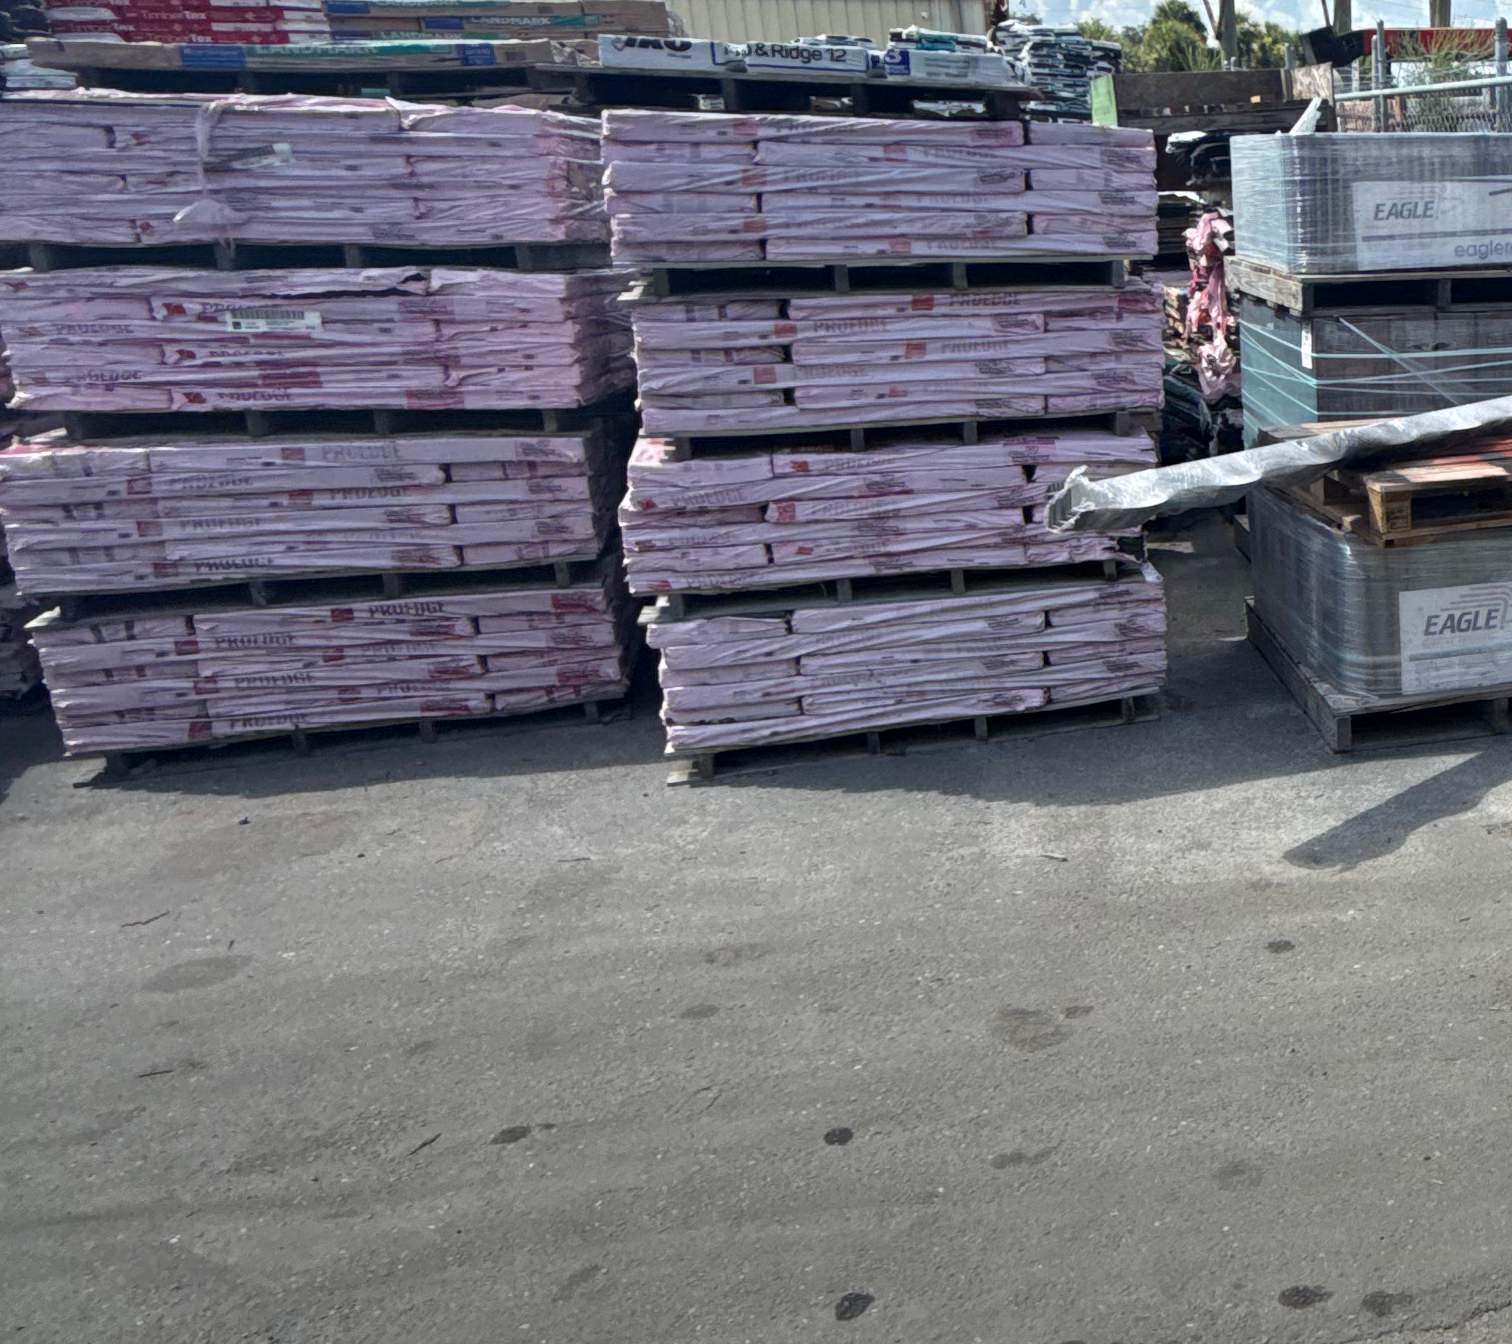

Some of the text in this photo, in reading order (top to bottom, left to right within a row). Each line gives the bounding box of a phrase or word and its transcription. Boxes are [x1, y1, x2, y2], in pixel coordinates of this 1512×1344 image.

[470, 16, 552, 27] LANDMARK
[755, 42, 769, 57] &
[771, 42, 822, 65] Ridge
[829, 48, 847, 62] 12
[1373, 199, 1435, 222] EAGLE
[1423, 607, 1501, 637] EAGLE
